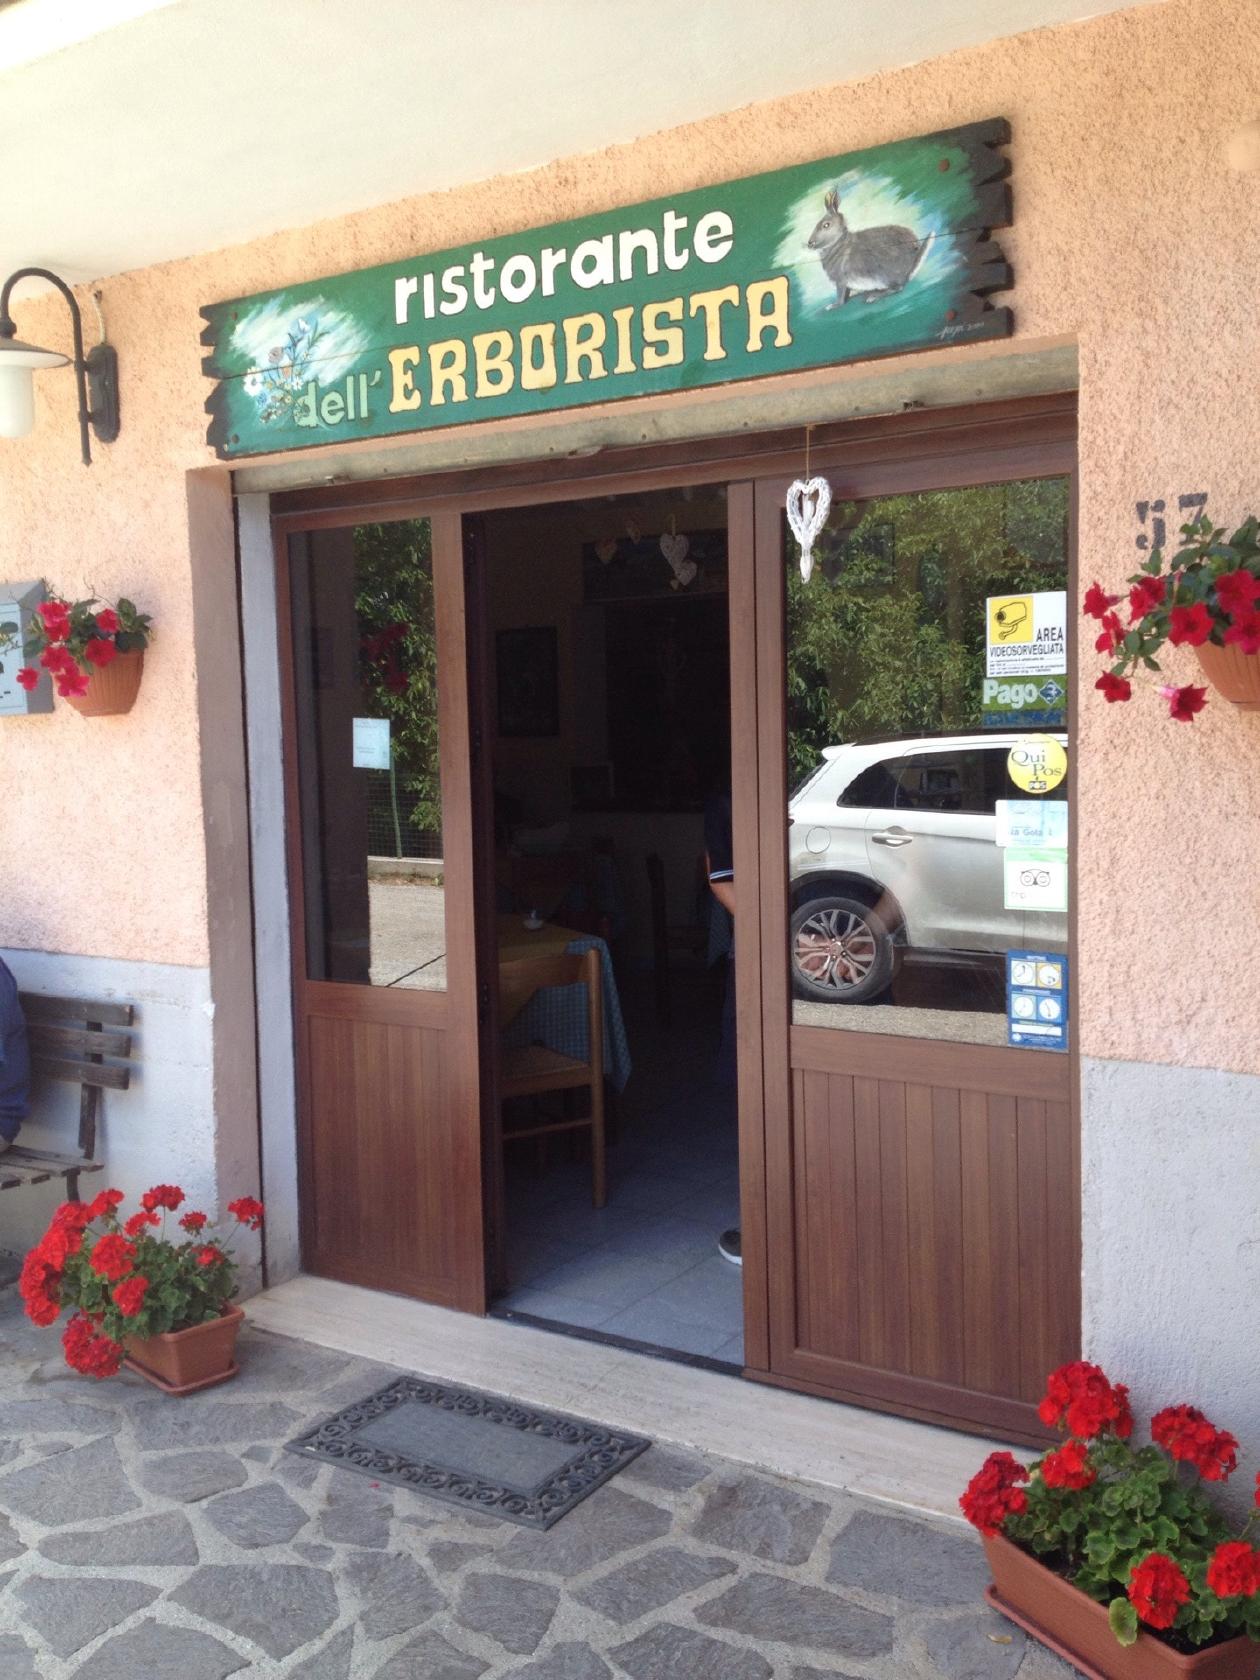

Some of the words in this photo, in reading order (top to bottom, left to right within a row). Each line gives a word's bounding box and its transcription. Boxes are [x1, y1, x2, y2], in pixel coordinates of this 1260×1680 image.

[393, 209, 734, 325] ristorante
[294, 369, 381, 427] dell'
[388, 275, 793, 413] ERBORISTA
[1036, 627, 1064, 642] AREA
[990, 643, 1064, 657] VIDEOSORVEGLIATA
[983, 679, 1038, 709] Pago
[1011, 750, 1046, 766] Qui
[1032, 764, 1062, 777] Pos
